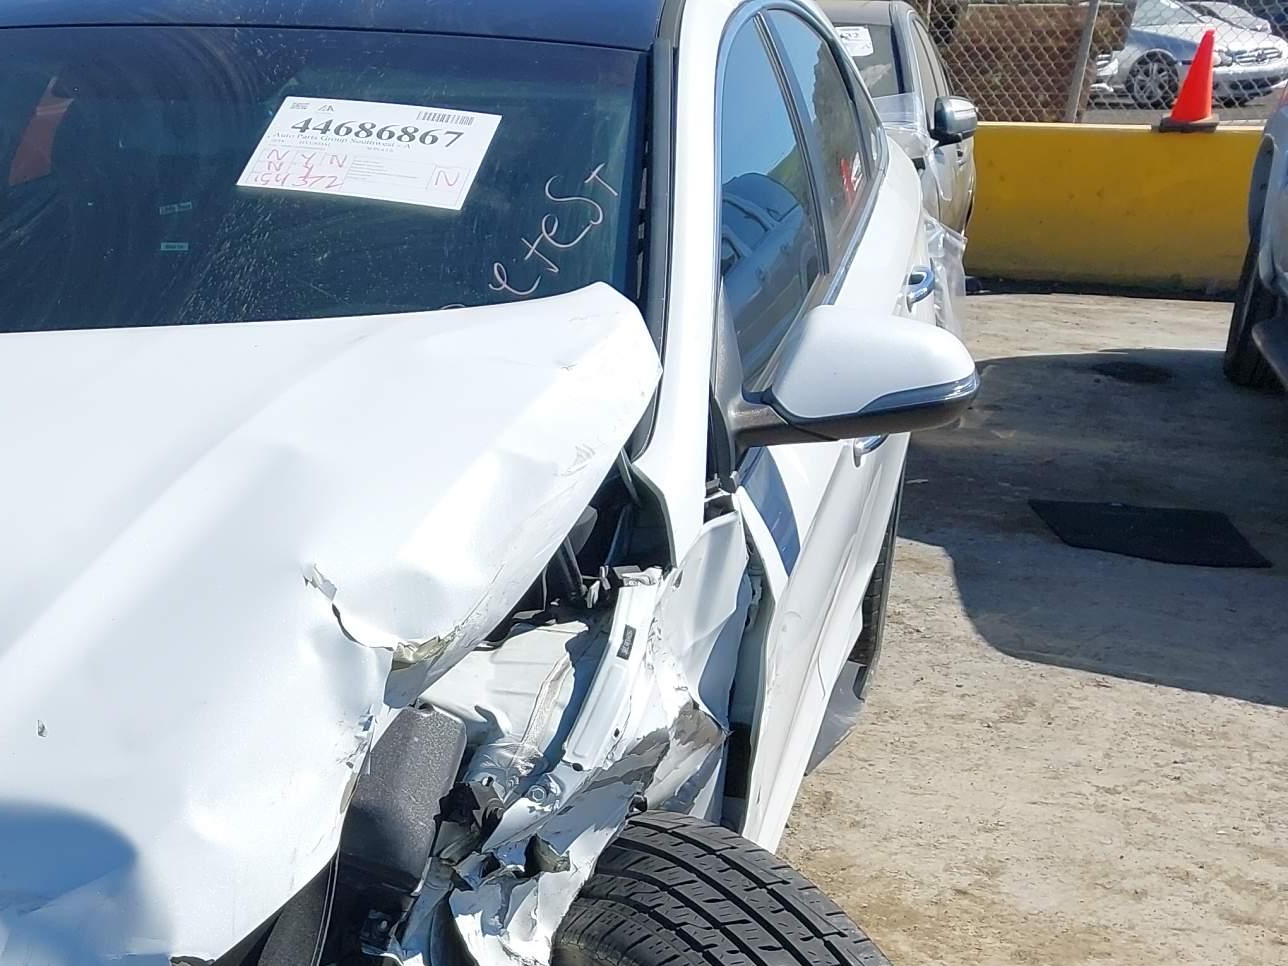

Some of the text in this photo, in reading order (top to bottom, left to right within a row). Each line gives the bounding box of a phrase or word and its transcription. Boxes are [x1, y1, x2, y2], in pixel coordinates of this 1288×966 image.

[291, 117, 465, 148] 44686867
[296, 133, 318, 142] Parts
[320, 134, 349, 144] Group
[349, 137, 396, 149] Southwest
